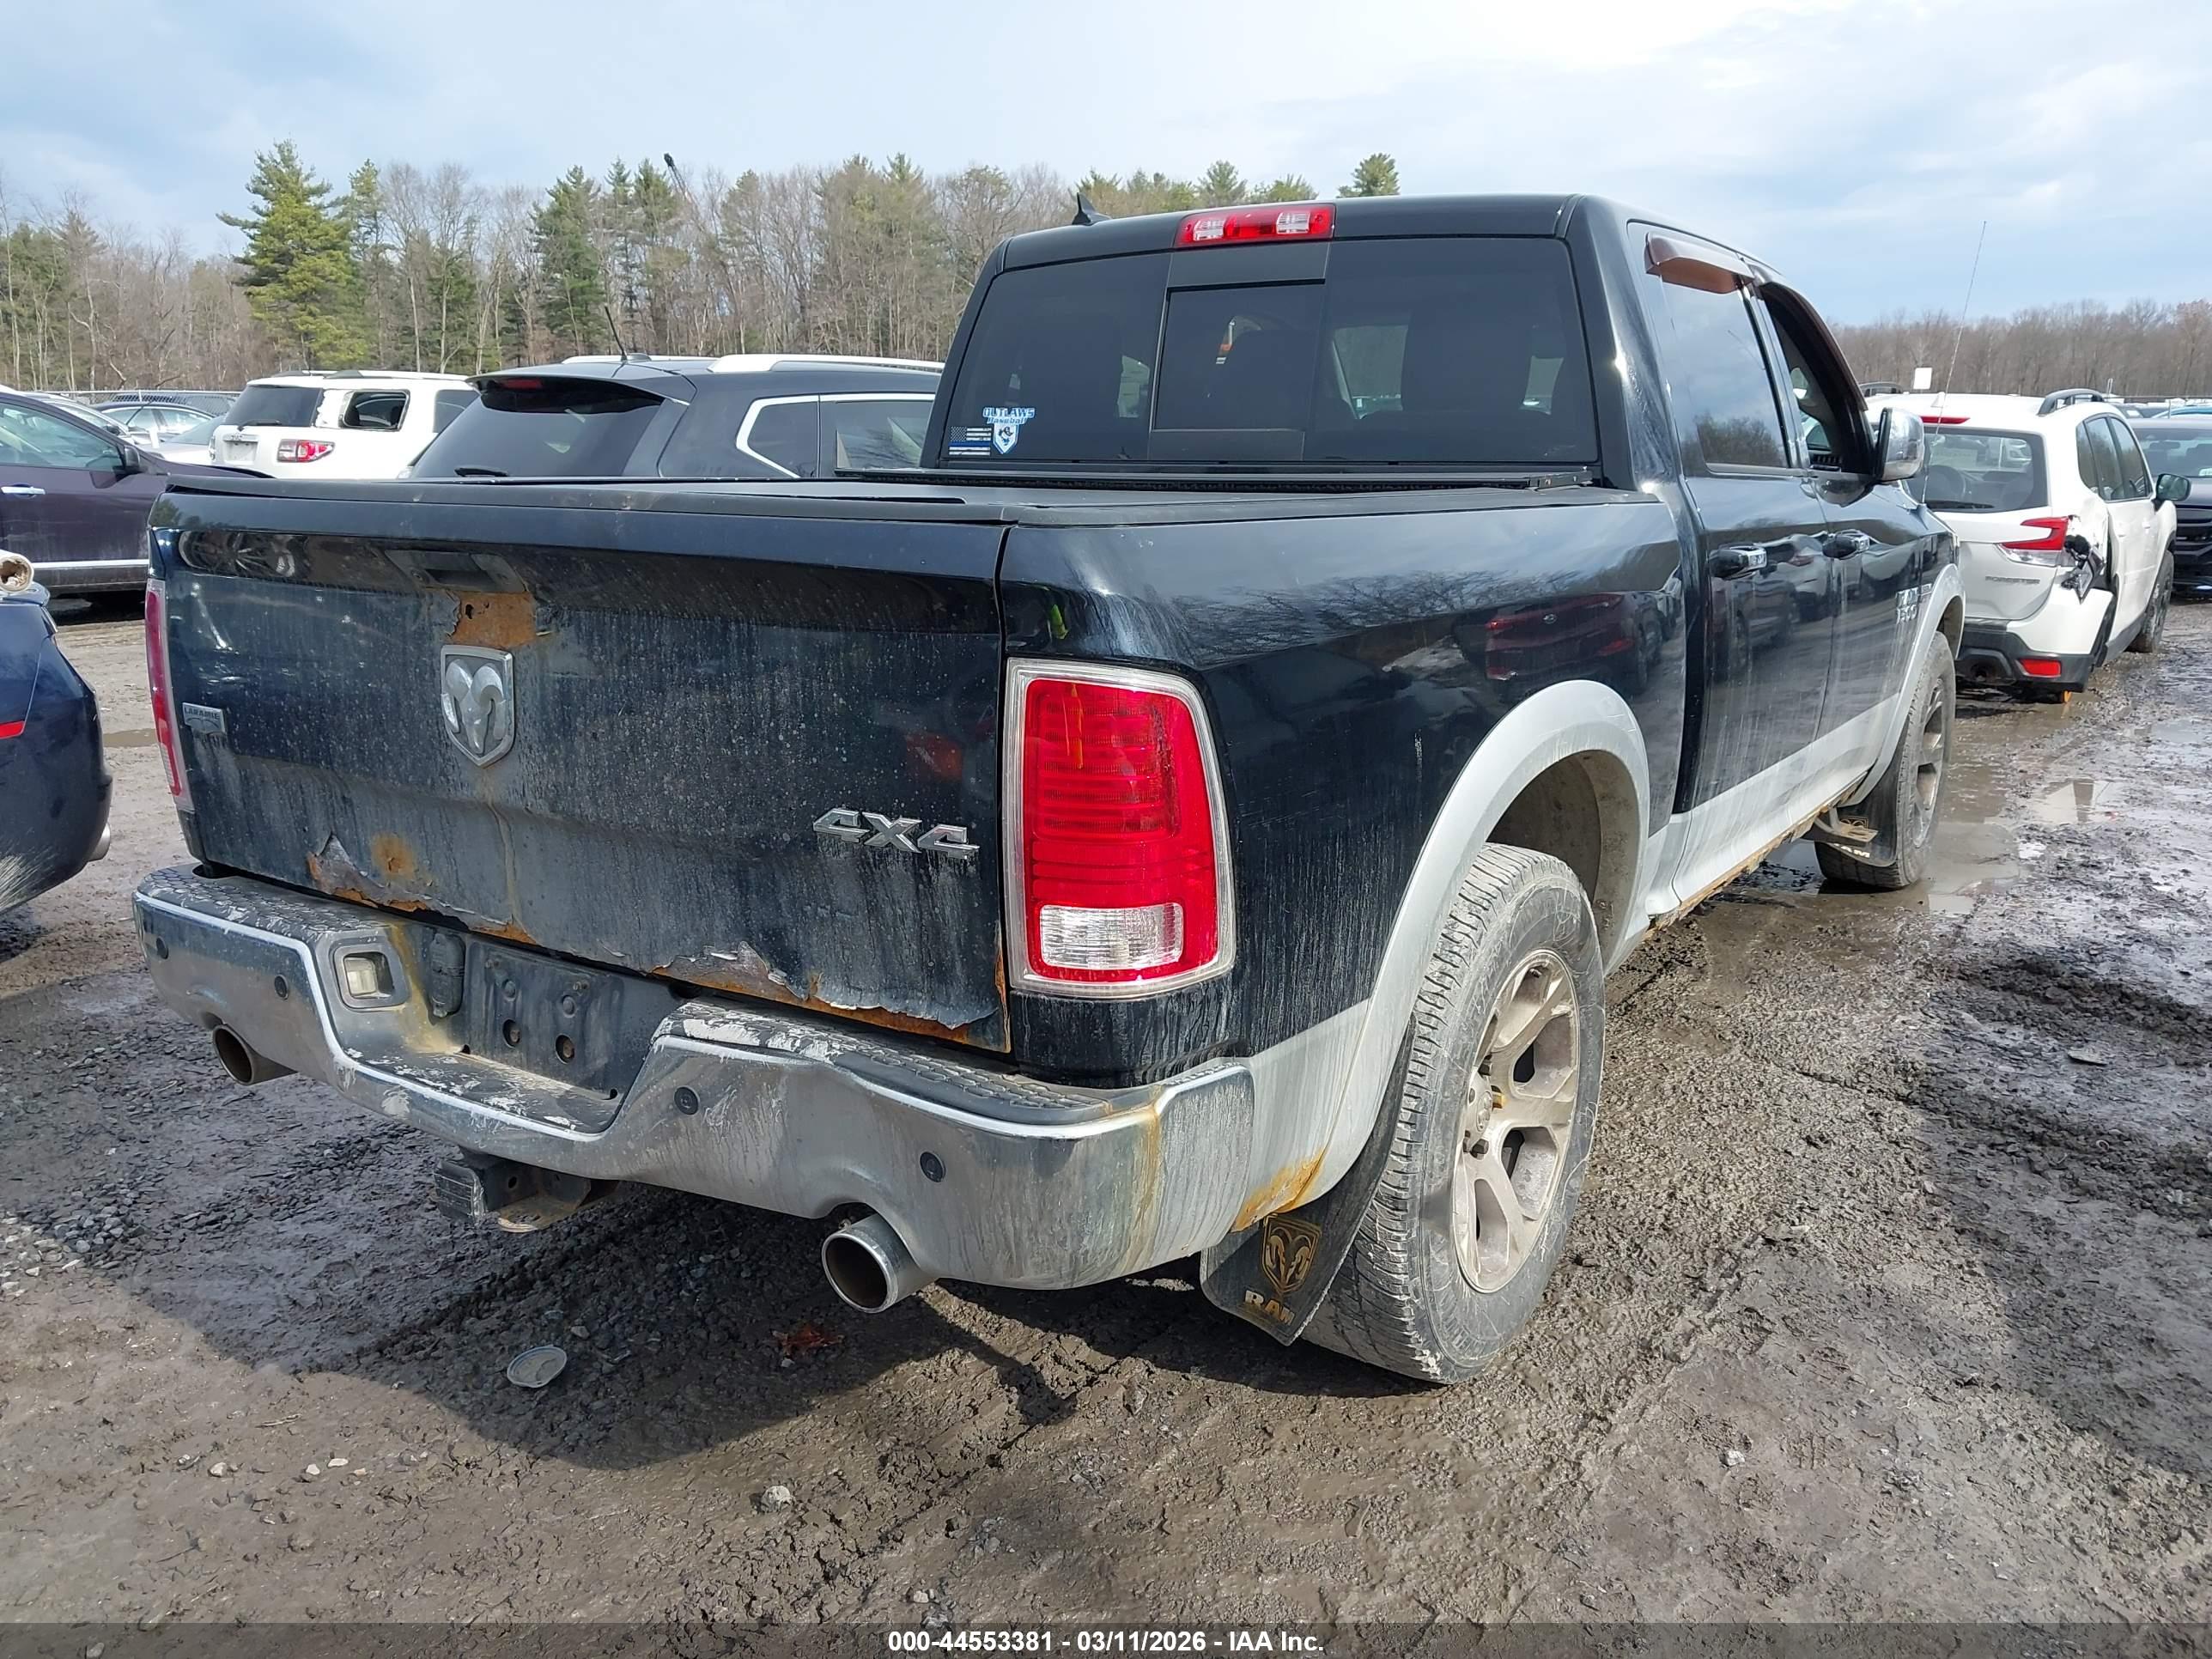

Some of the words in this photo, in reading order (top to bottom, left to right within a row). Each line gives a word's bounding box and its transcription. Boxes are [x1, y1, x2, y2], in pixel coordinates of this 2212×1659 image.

[983, 407, 1035, 417] OUTLAWS
[185, 707, 220, 720] LARAMIE
[1245, 1290, 1295, 1326] RAM
